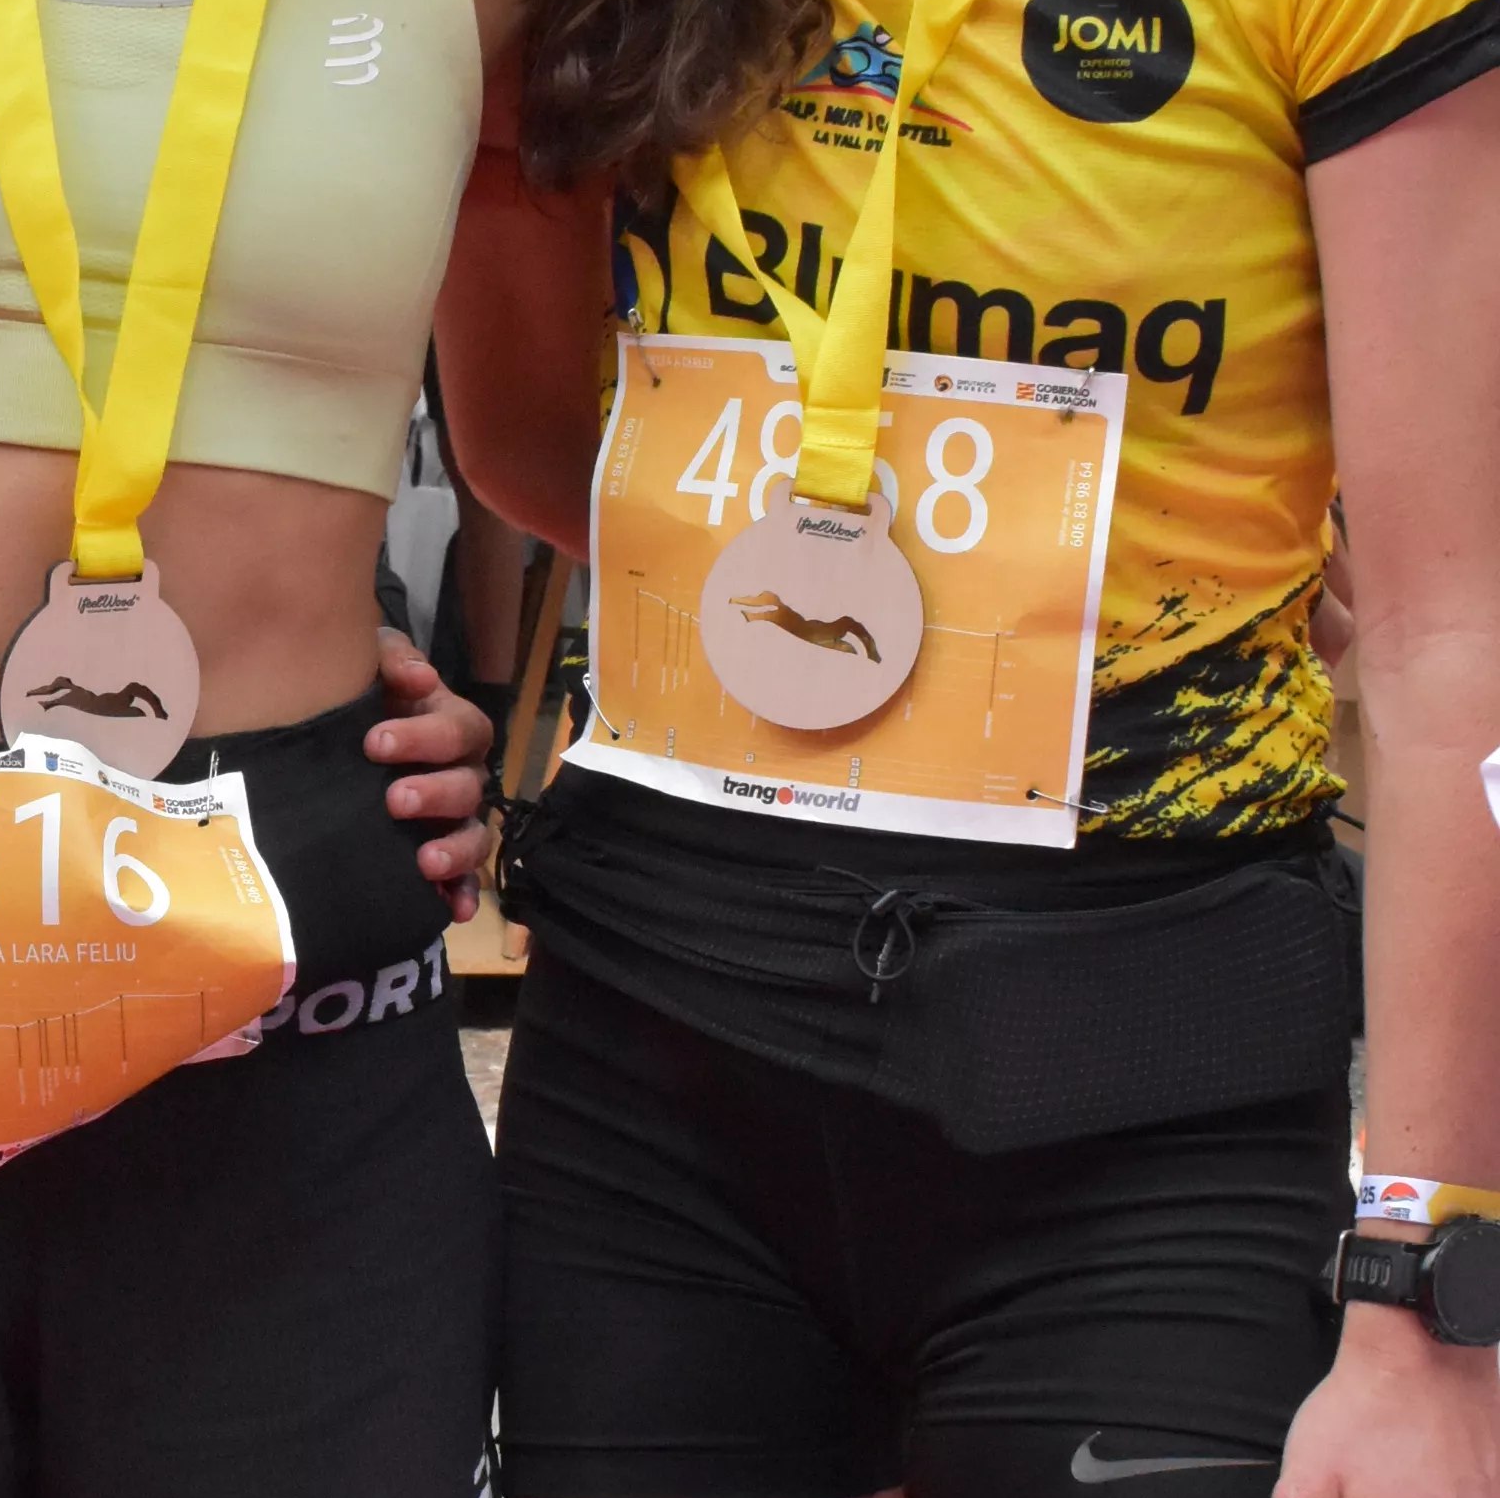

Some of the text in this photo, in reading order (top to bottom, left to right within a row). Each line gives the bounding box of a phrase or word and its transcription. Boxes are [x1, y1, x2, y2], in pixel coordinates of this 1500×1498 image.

[1052, 14, 1161, 54] JOMI
[1035, 393, 1050, 403] DE
[1036, 384, 1091, 398] GOBIERNO
[1069, 461, 1094, 547] 606 83 98 64
[165, 794, 214, 807] GOBIERNO
[167, 807, 180, 815] DE
[12, 943, 69, 963] LARA
[76, 942, 137, 962] FELIU
